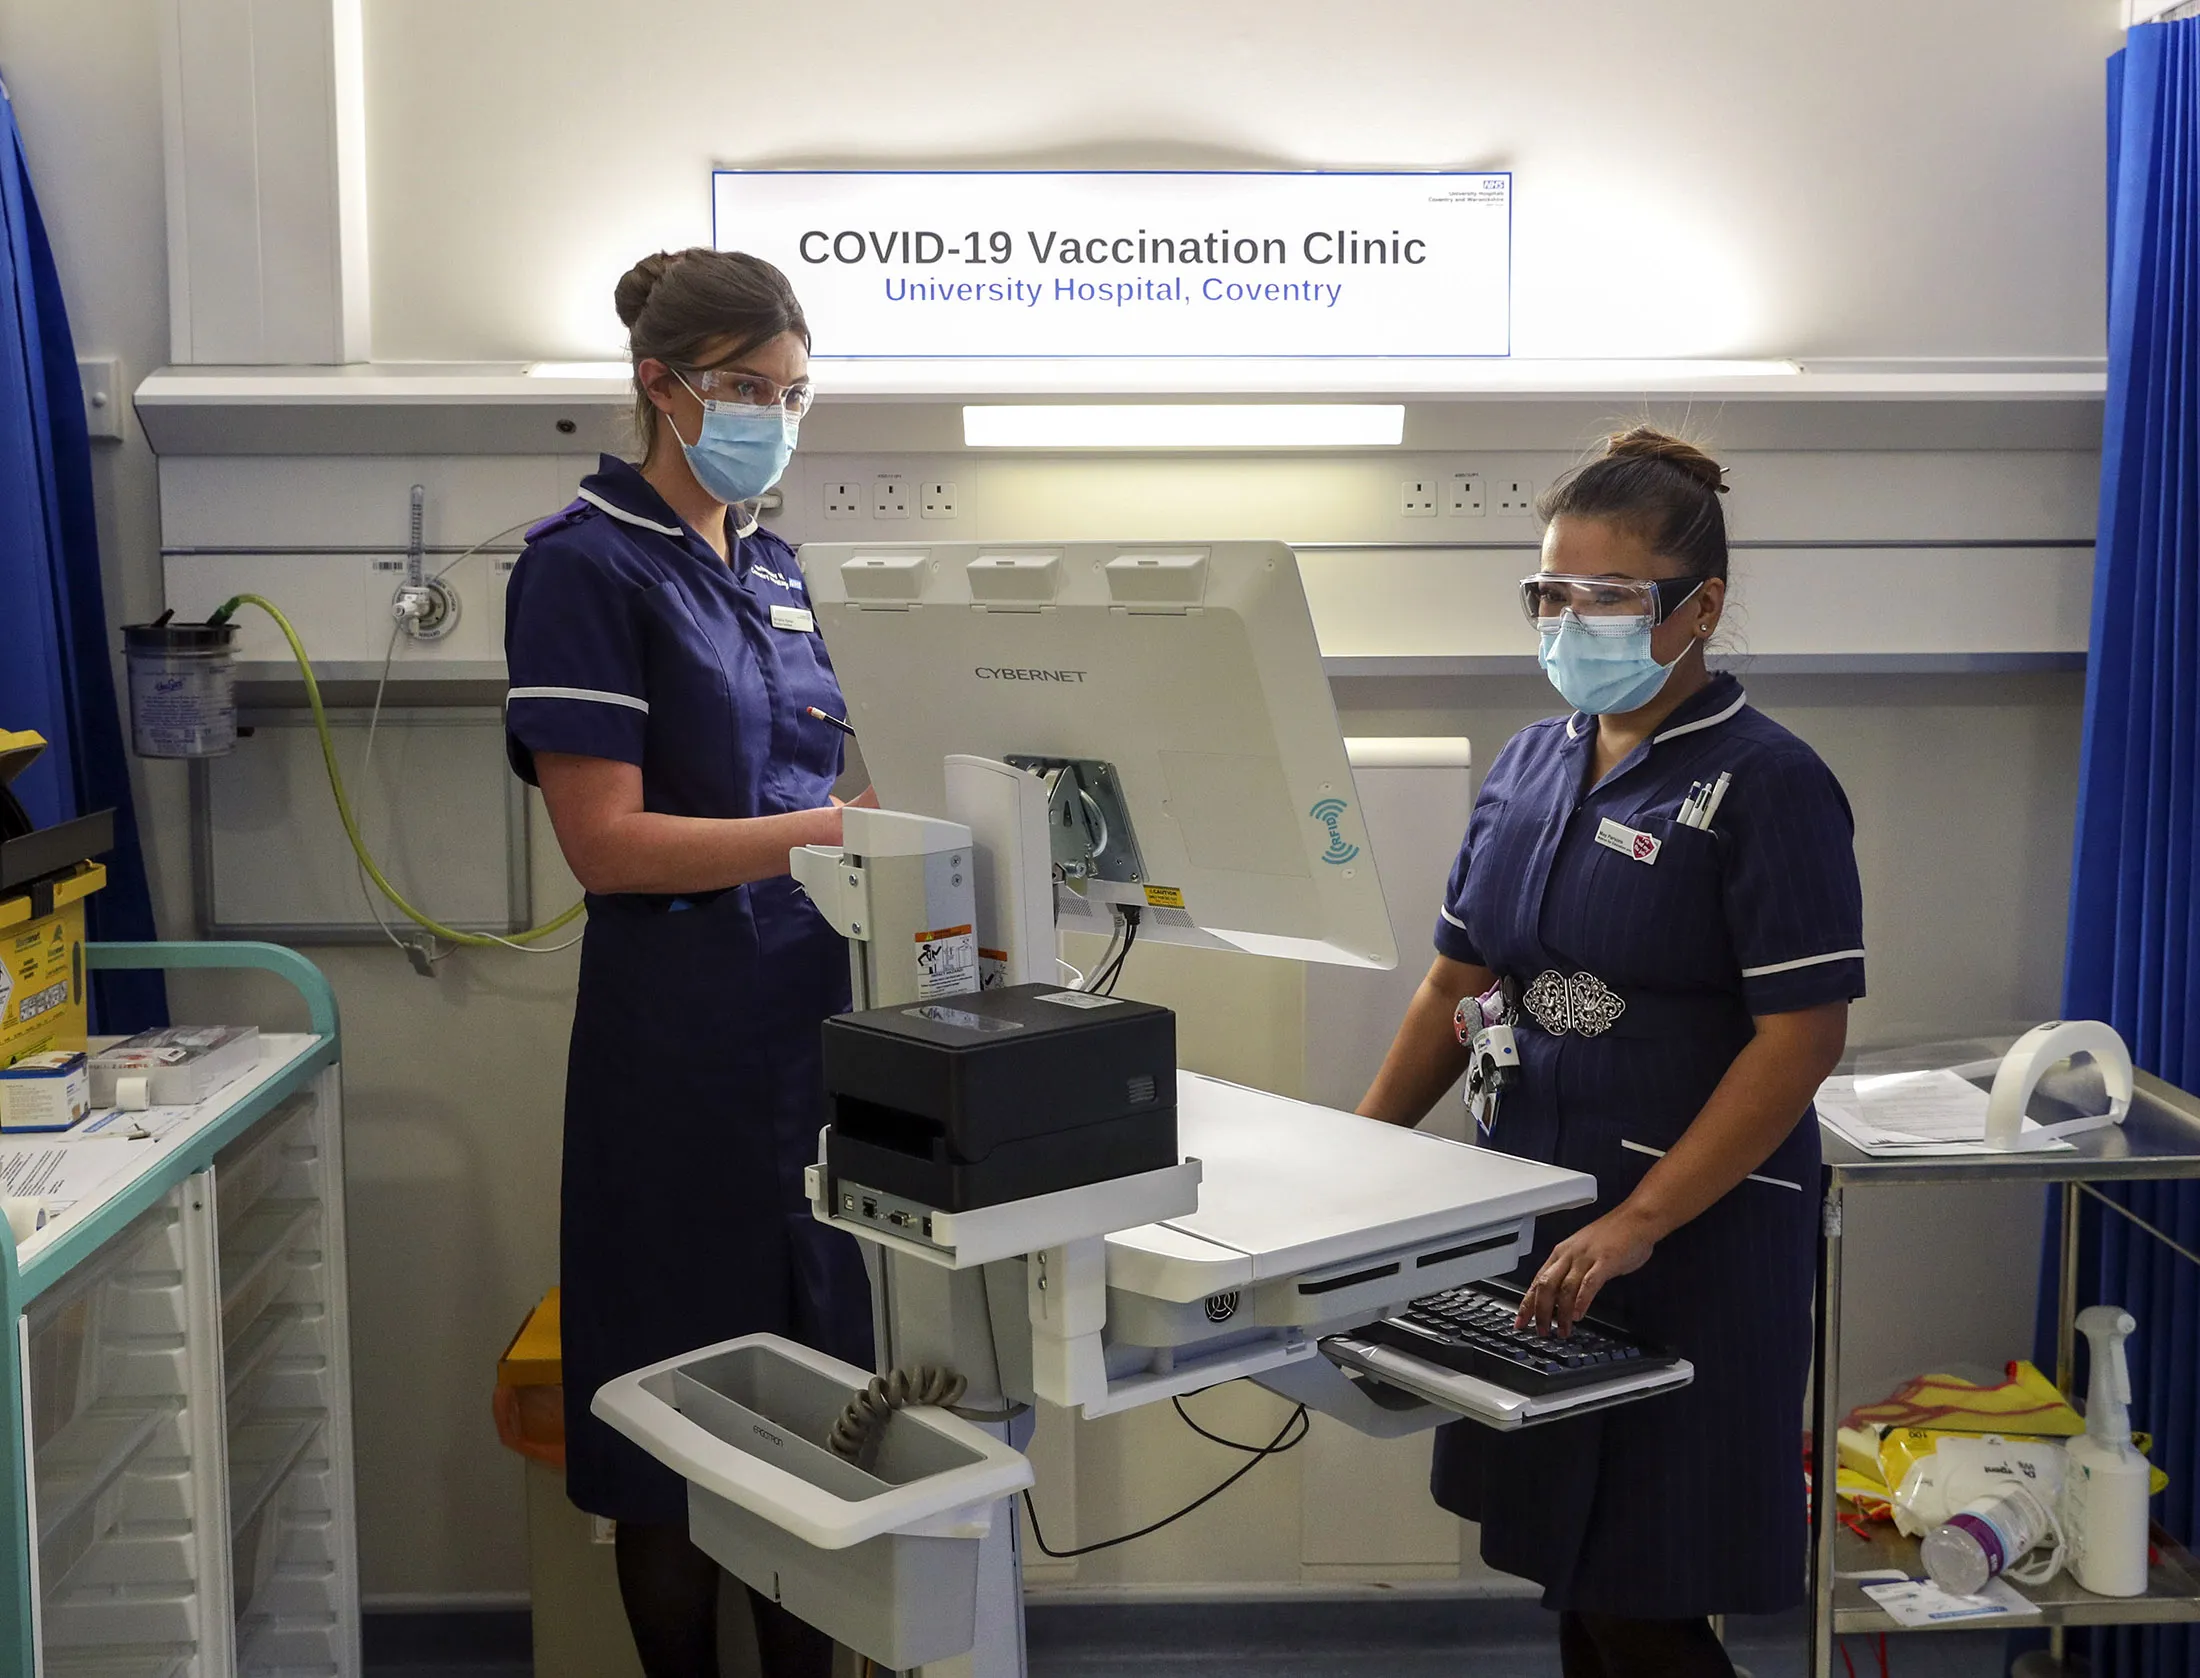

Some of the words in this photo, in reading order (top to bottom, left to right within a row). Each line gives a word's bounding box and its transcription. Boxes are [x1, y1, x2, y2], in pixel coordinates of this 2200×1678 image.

[1482, 179, 1505, 190] NHS
[799, 230, 1012, 264] COVID-19
[1028, 229, 1286, 264] Vaccination
[1303, 230, 1426, 264] Clinic
[885, 277, 1043, 308] University
[1054, 277, 1190, 308] Hospital,
[1203, 277, 1342, 308] Coventry
[974, 666, 1088, 684] CYBERNET
[1326, 816, 1342, 846] RFID
